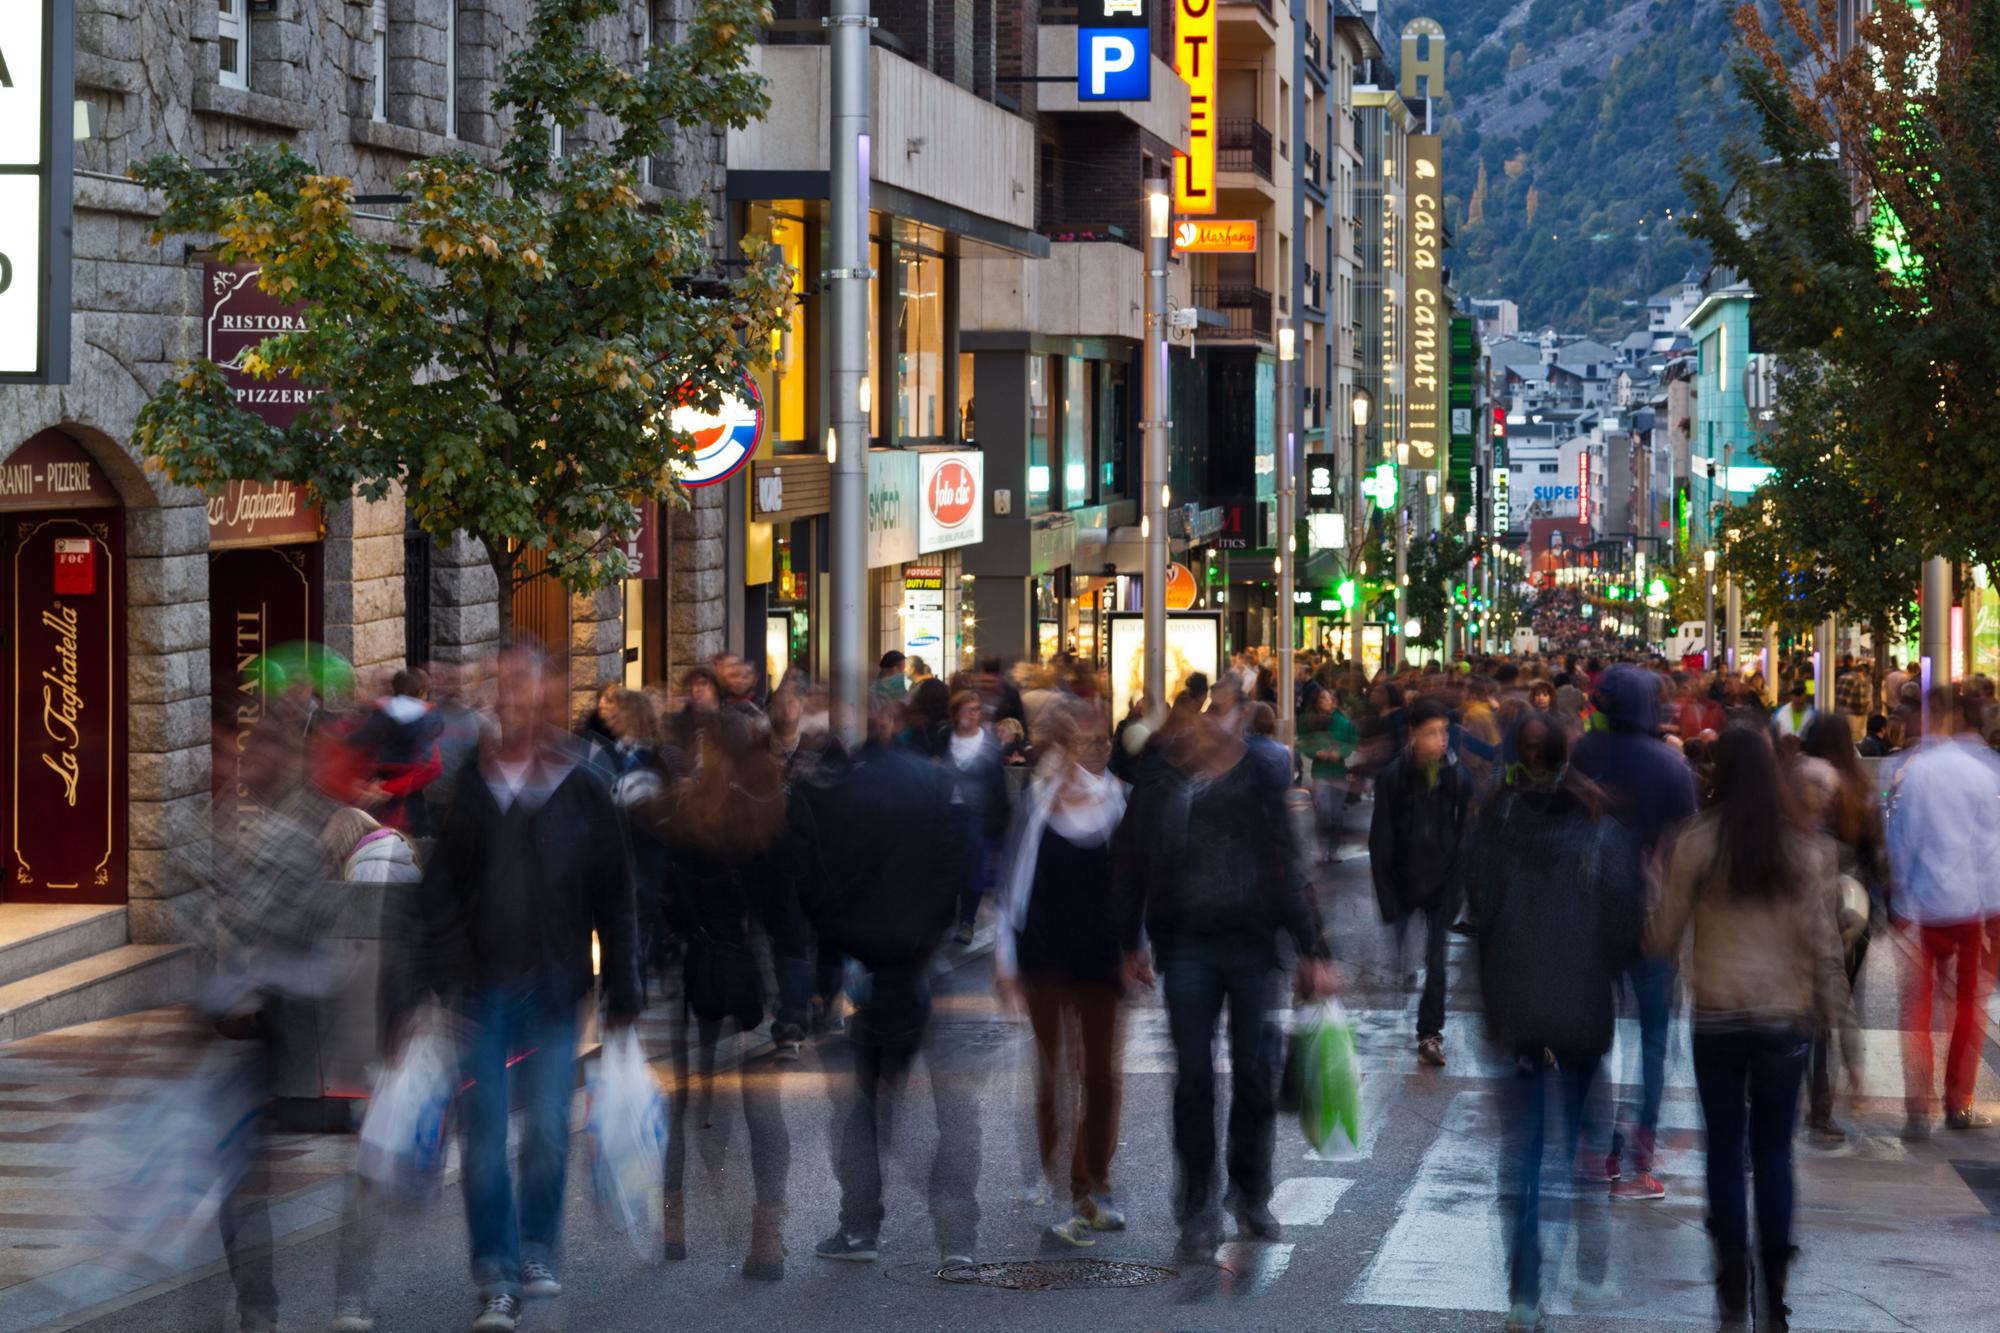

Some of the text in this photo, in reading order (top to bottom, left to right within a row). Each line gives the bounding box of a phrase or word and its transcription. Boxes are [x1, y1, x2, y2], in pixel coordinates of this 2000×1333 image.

[1092, 36, 1135, 94] P
[1415, 194, 1436, 270] casa
[1415, 287, 1437, 392] canut
[47, 462, 91, 492] PIZZERIE
[906, 568, 942, 576] FOTOCLIC
[906, 578, 942, 588] DUTY FREE
[42, 606, 84, 807] La Tagliatella
